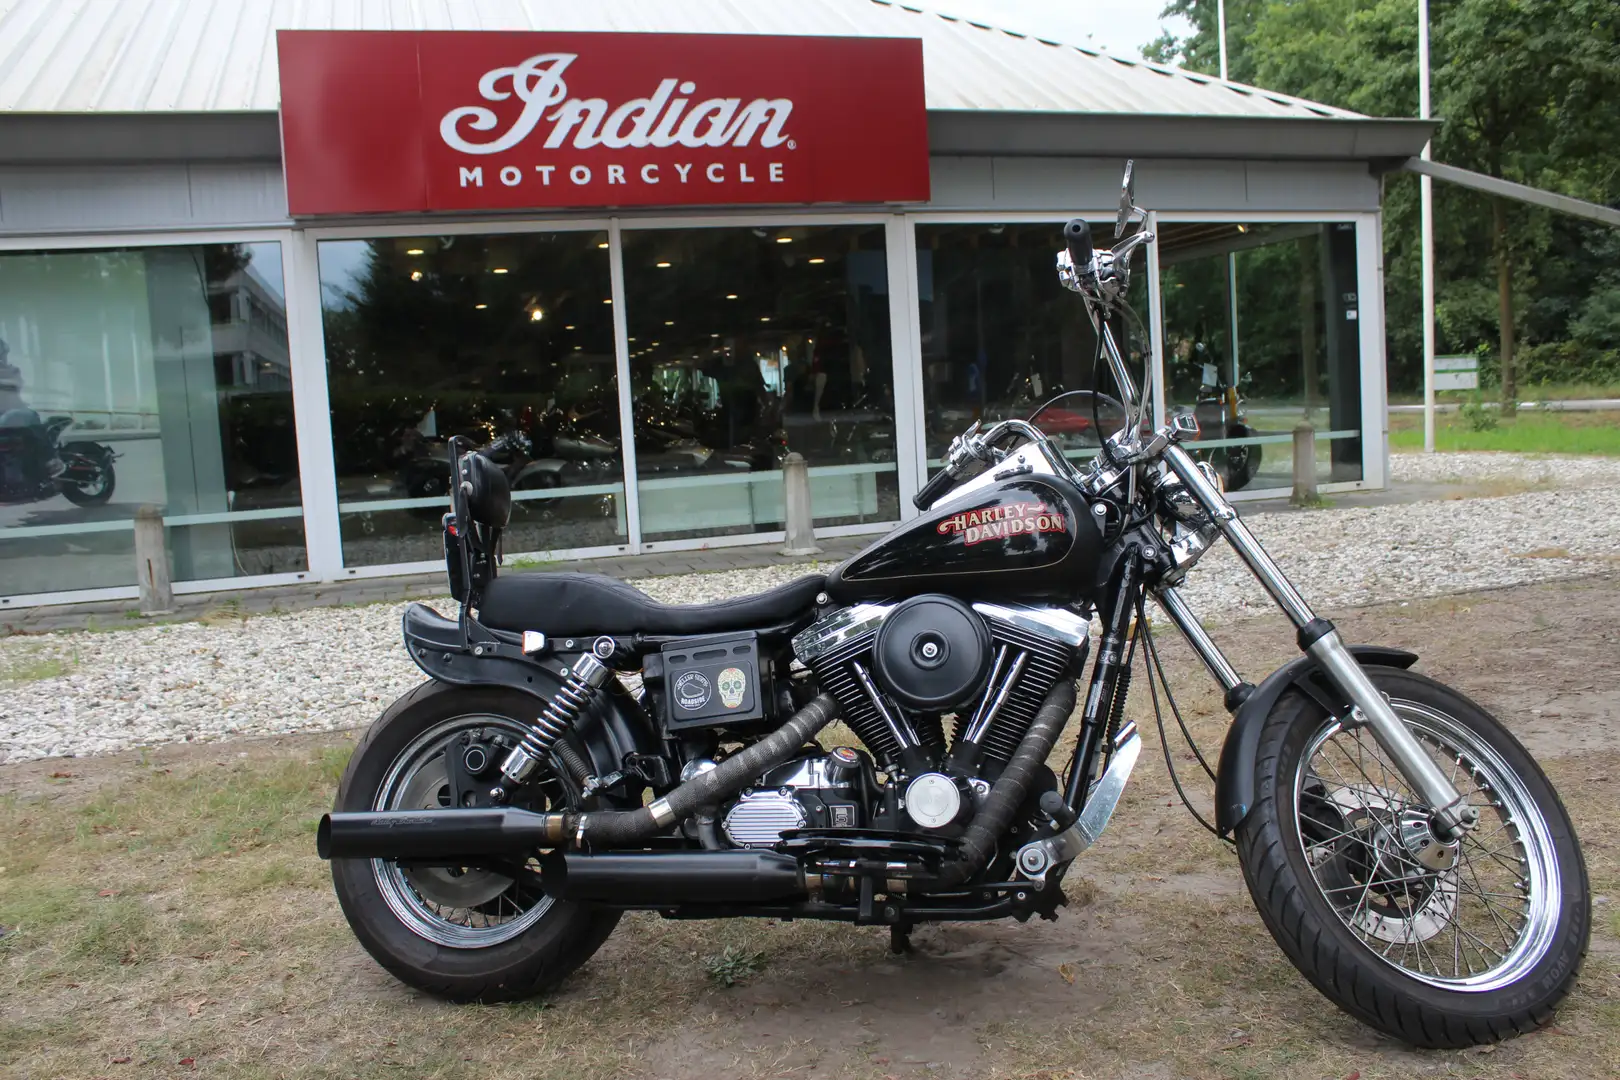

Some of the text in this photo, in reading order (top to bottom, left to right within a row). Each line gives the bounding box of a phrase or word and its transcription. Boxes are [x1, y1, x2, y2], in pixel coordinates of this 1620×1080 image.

[459, 163, 784, 187] MOTORCYCLE
[938, 503, 1045, 533] HARLEY
[966, 515, 1063, 543] DAVIDSON
